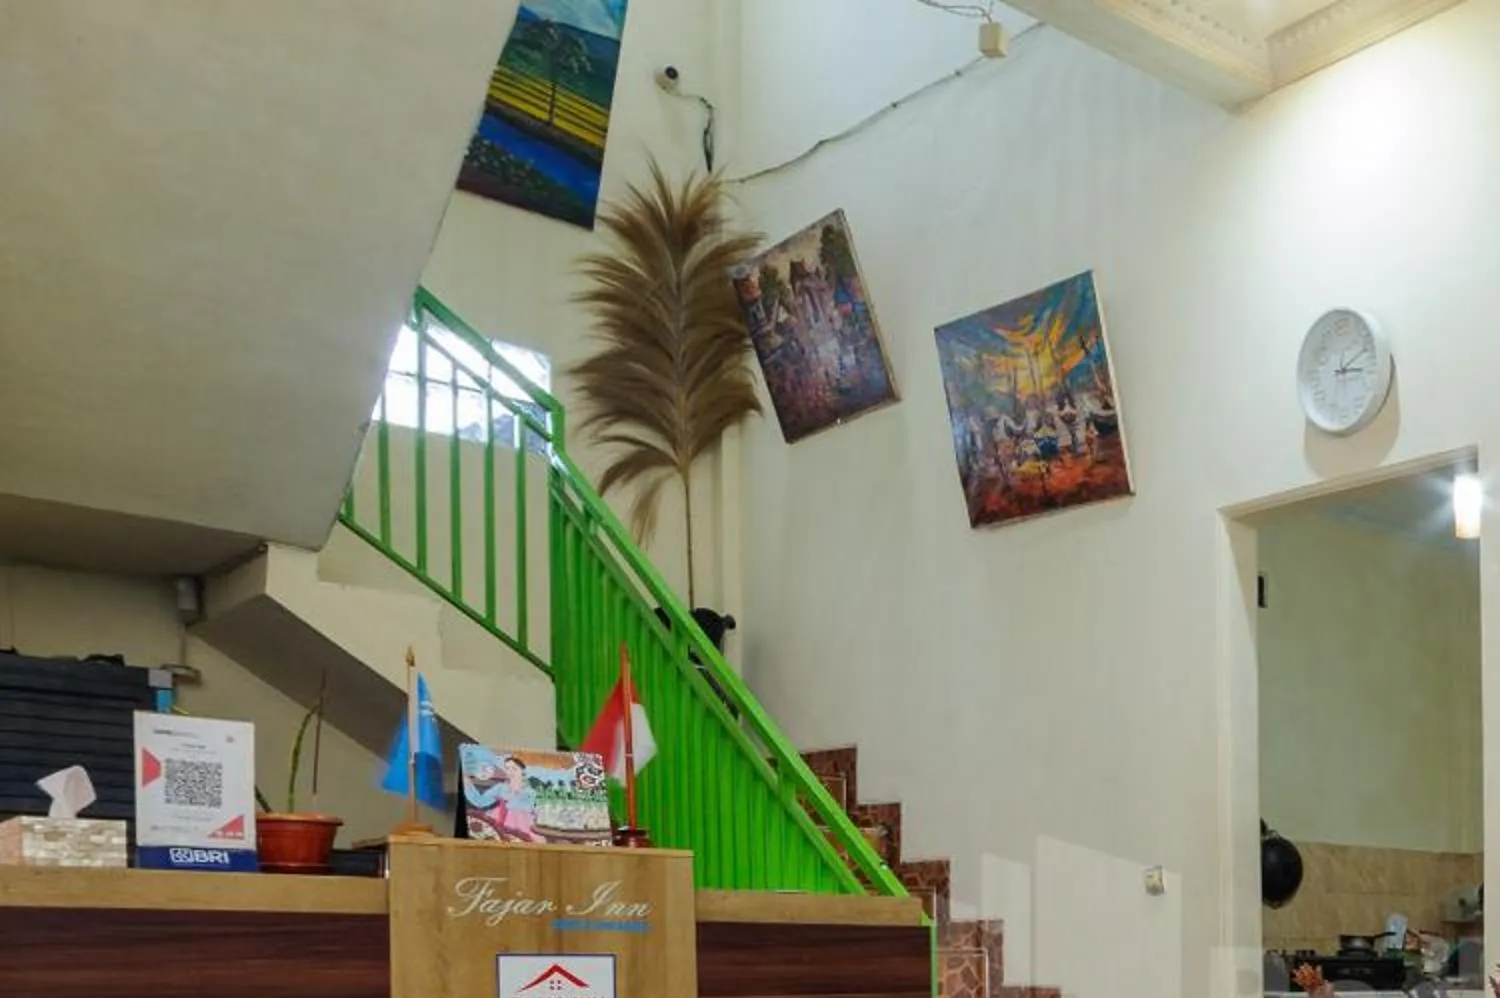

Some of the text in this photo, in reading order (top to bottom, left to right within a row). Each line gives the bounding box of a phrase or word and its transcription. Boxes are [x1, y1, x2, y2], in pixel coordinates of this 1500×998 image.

[194, 849, 230, 865] BRI
[448, 877, 652, 927] Fajar Inn
